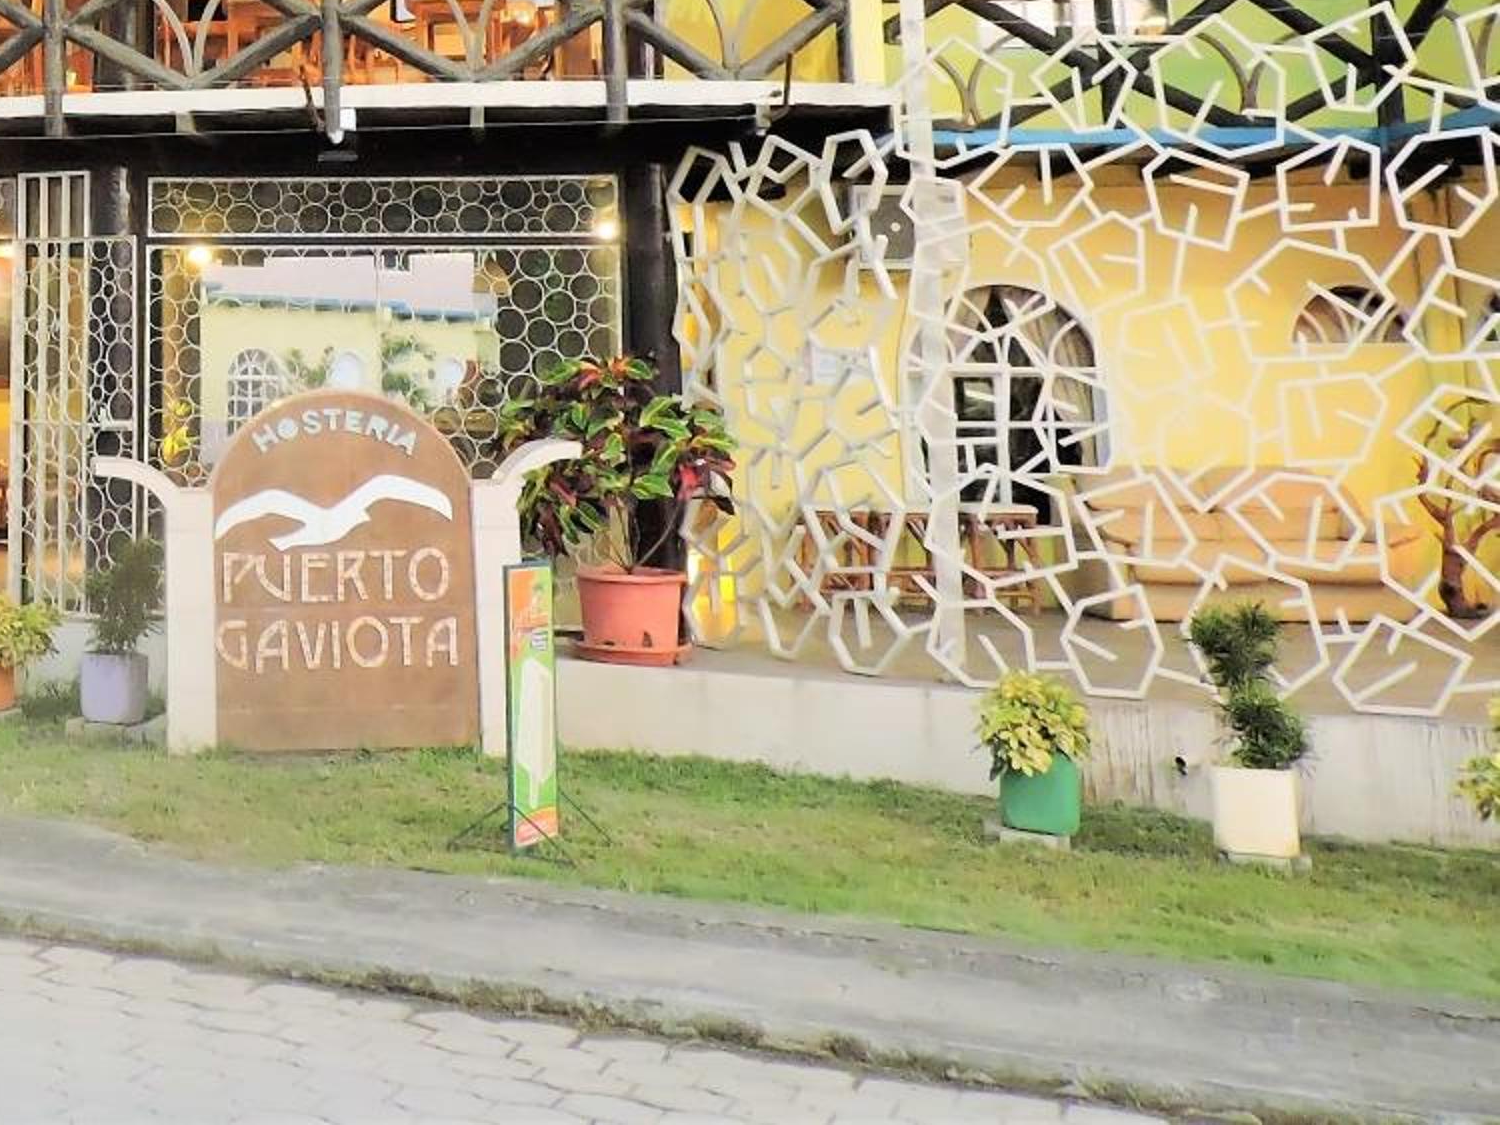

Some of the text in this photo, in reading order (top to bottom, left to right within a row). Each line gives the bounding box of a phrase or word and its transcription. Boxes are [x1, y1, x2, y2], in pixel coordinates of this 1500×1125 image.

[251, 408, 417, 457] HOSTERIA
[222, 547, 451, 603] PUERTO
[215, 616, 459, 673] GAVIOTA
